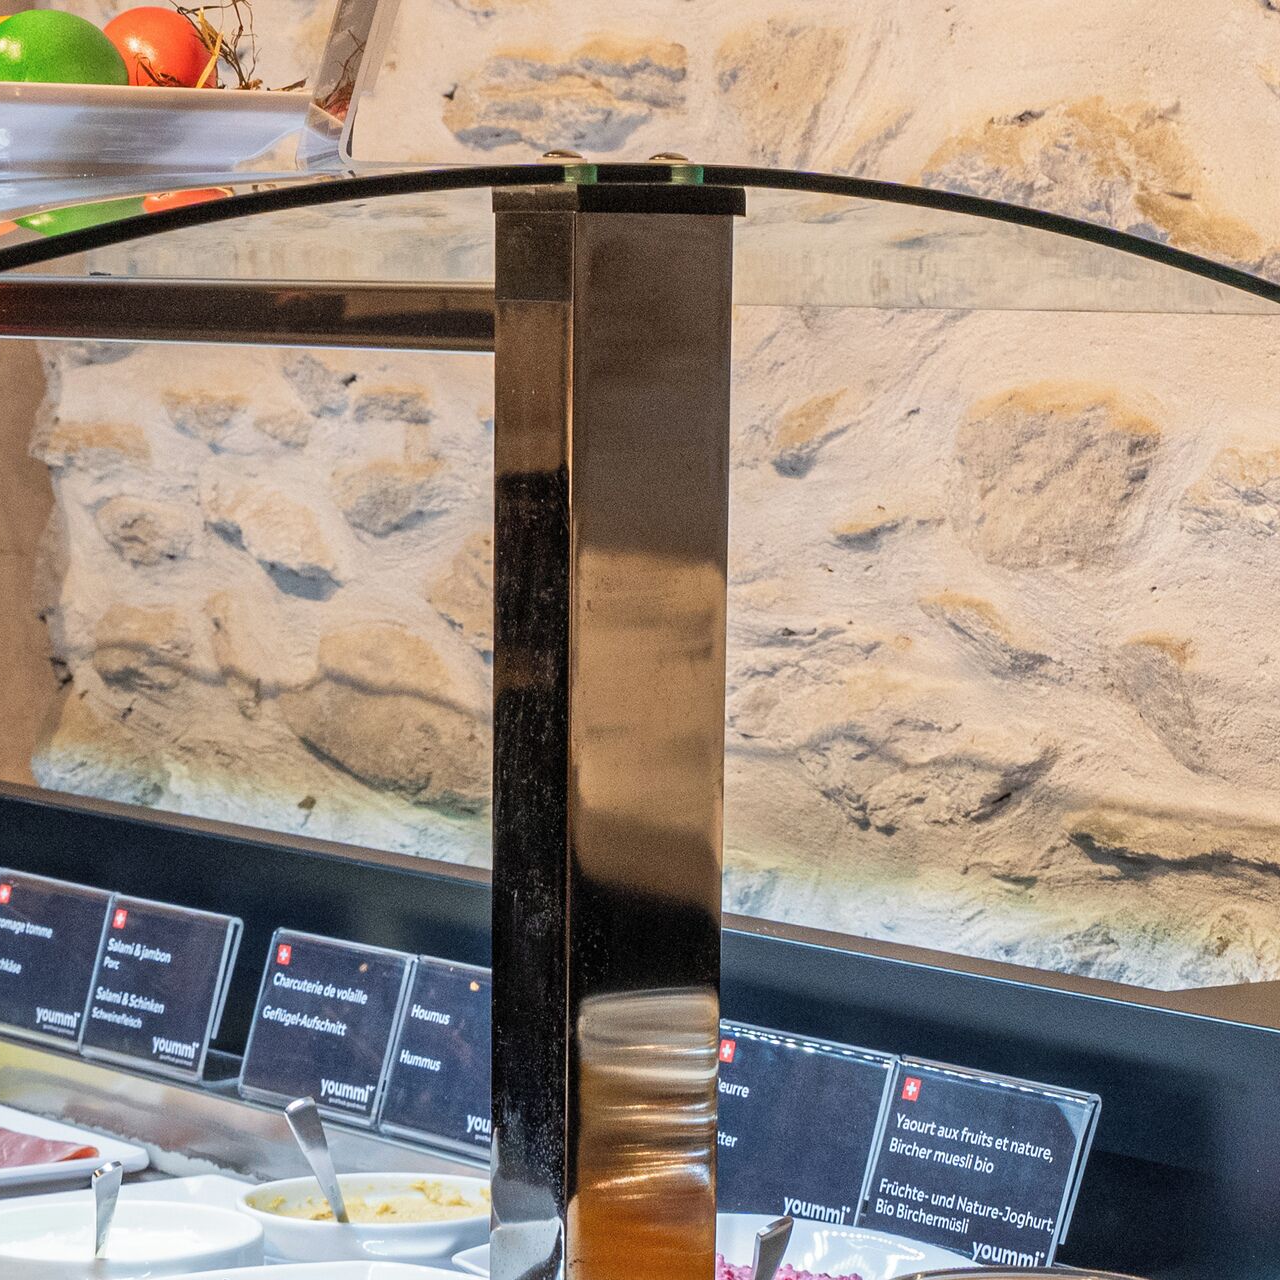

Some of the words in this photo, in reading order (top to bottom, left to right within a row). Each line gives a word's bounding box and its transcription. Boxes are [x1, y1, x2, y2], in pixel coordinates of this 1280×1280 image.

[25, 922, 53, 939] tomme
[103, 956, 120, 970] Porc
[107, 938, 135, 956] Salami
[134, 943, 141, 957] &
[139, 945, 171, 964] jambon
[95, 986, 123, 1004] Salami
[121, 992, 129, 1006] &
[128, 994, 165, 1014] Schinken
[273, 971, 323, 995] Charcuterie
[323, 983, 336, 998] de
[336, 987, 368, 1005] volaille
[36, 1006, 81, 1028] yoummi
[91, 1006, 142, 1029] Schweinefleisch
[262, 1005, 348, 1036] Geflügel-Aufschnitt
[411, 1004, 451, 1025] Houmus
[152, 1036, 200, 1059] yoummi
[400, 1049, 441, 1071] Hummus
[320, 1078, 375, 1103] yoummi
[718, 1078, 750, 1098] eurre
[466, 1114, 492, 1133] you
[717, 1131, 738, 1148] tter
[896, 1112, 936, 1136] Yaourt
[937, 1125, 960, 1140] aux
[960, 1127, 993, 1148] fruits
[995, 1137, 1010, 1151] et
[1010, 1140, 1054, 1163] nature,
[889, 1137, 932, 1160] Bircher
[933, 1148, 974, 1169] muesli
[974, 1156, 994, 1174] bio
[783, 1197, 850, 1225] yoummi
[875, 1198, 894, 1216] Bio
[896, 1203, 970, 1234] Birchermüsli
[879, 1178, 929, 1202] Früchte-
[931, 1193, 956, 1209] und
[956, 1196, 1055, 1235] Nature-Joghurt,
[972, 1241, 1045, 1267] yoummi
